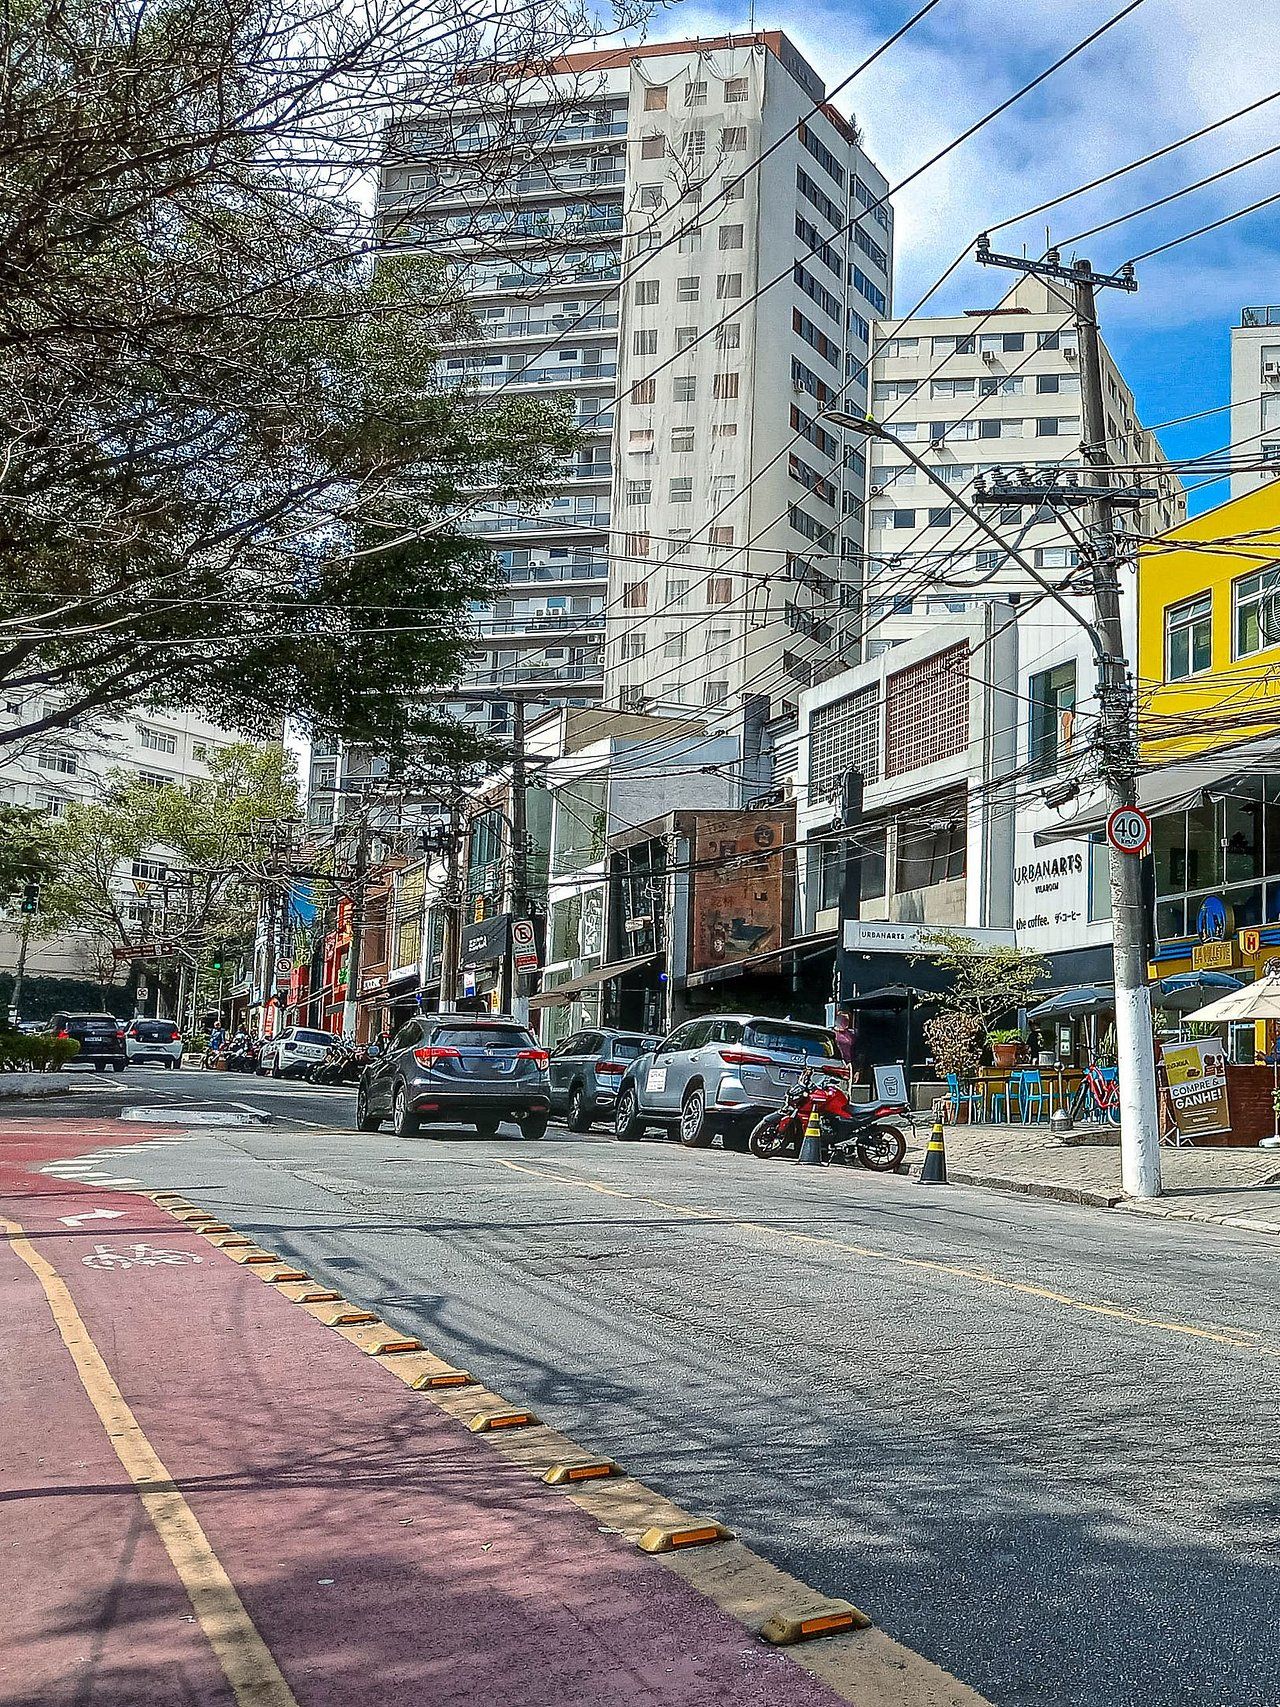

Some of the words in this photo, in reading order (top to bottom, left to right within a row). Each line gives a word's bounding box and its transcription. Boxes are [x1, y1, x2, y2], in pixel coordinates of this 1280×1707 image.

[1114, 818, 1141, 838] 40
[1014, 853, 1083, 884] URBANARTS
[1016, 918, 1027, 931] the
[861, 930, 905, 940] URBANARTS
[1172, 1079, 1211, 1097] COMPRE
[1212, 1077, 1220, 1086] &
[1175, 1088, 1223, 1110] GANHE!
